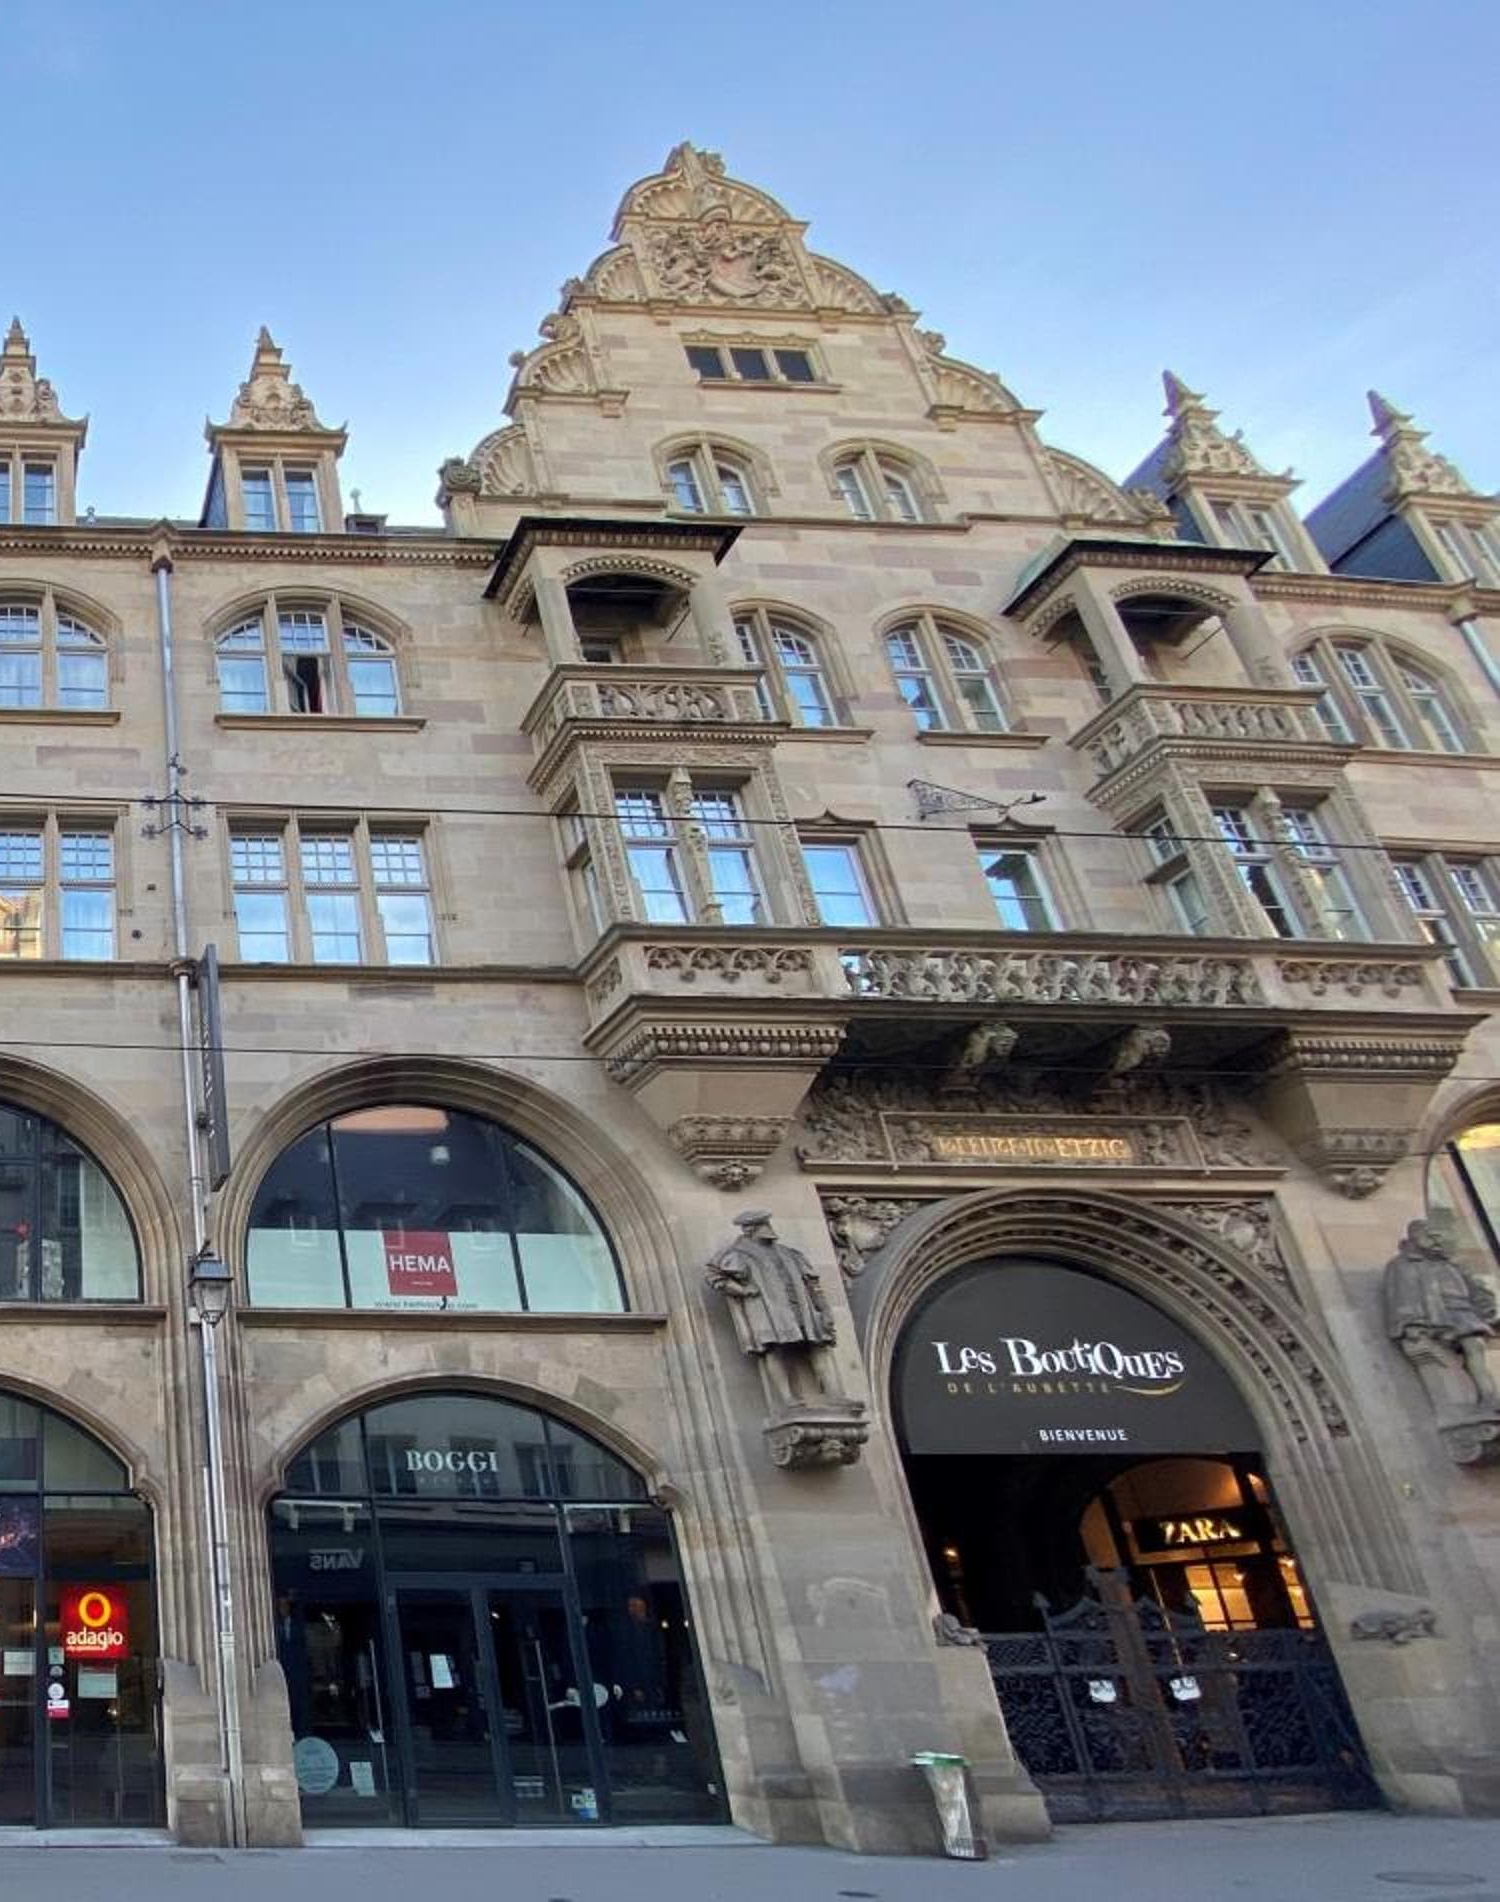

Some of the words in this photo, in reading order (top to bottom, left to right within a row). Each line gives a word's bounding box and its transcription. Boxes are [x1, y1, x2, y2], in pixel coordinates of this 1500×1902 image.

[389, 1254, 452, 1274] HEMA
[932, 1341, 998, 1375] Les
[1039, 1429, 1129, 1442] BIENVENUE
[405, 1450, 499, 1473] BOGGI
[1159, 1518, 1241, 1544] ZARA
[67, 1626, 124, 1651] adagio
